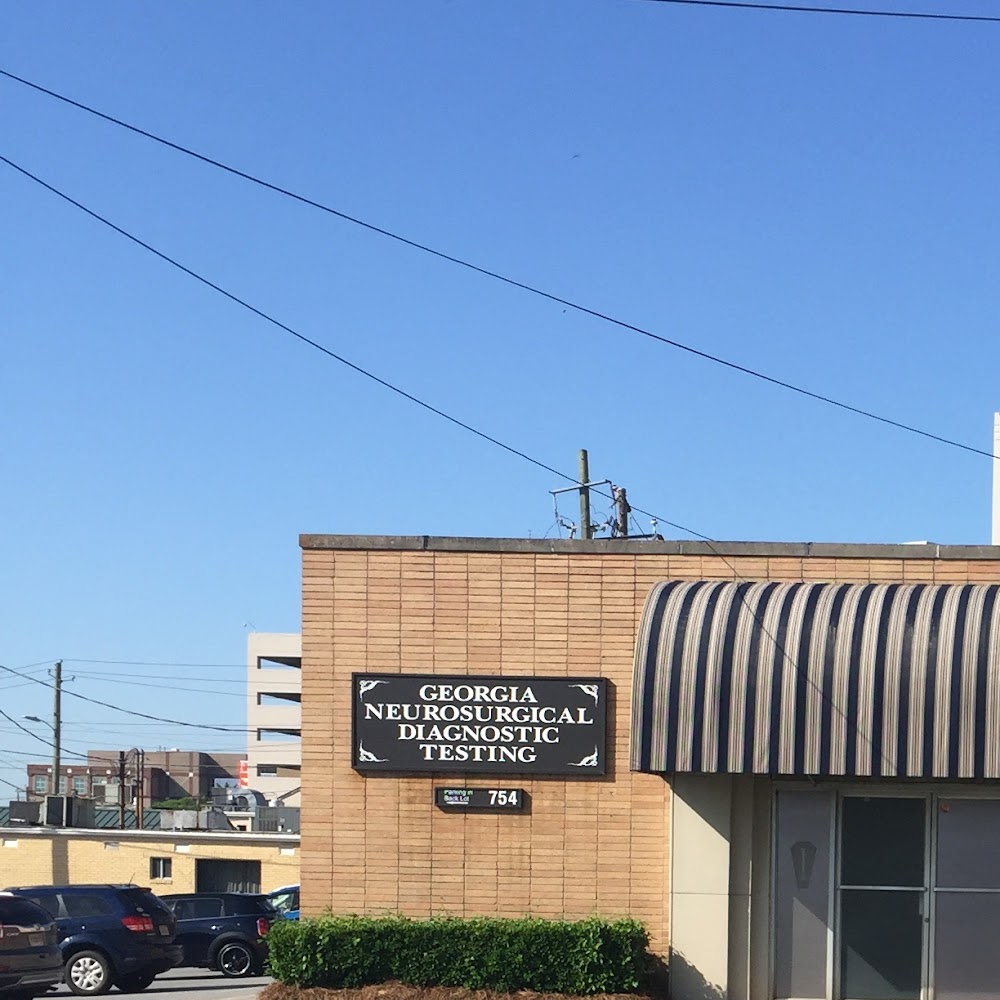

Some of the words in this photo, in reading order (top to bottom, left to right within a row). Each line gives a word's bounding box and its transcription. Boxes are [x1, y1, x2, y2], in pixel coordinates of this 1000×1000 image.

[419, 684, 539, 703] GEORGIA
[364, 703, 594, 725] NEUROSURGICAL
[397, 723, 560, 744] DIAGNOSTIC
[418, 743, 537, 763] TESTING
[488, 790, 518, 806] 754
